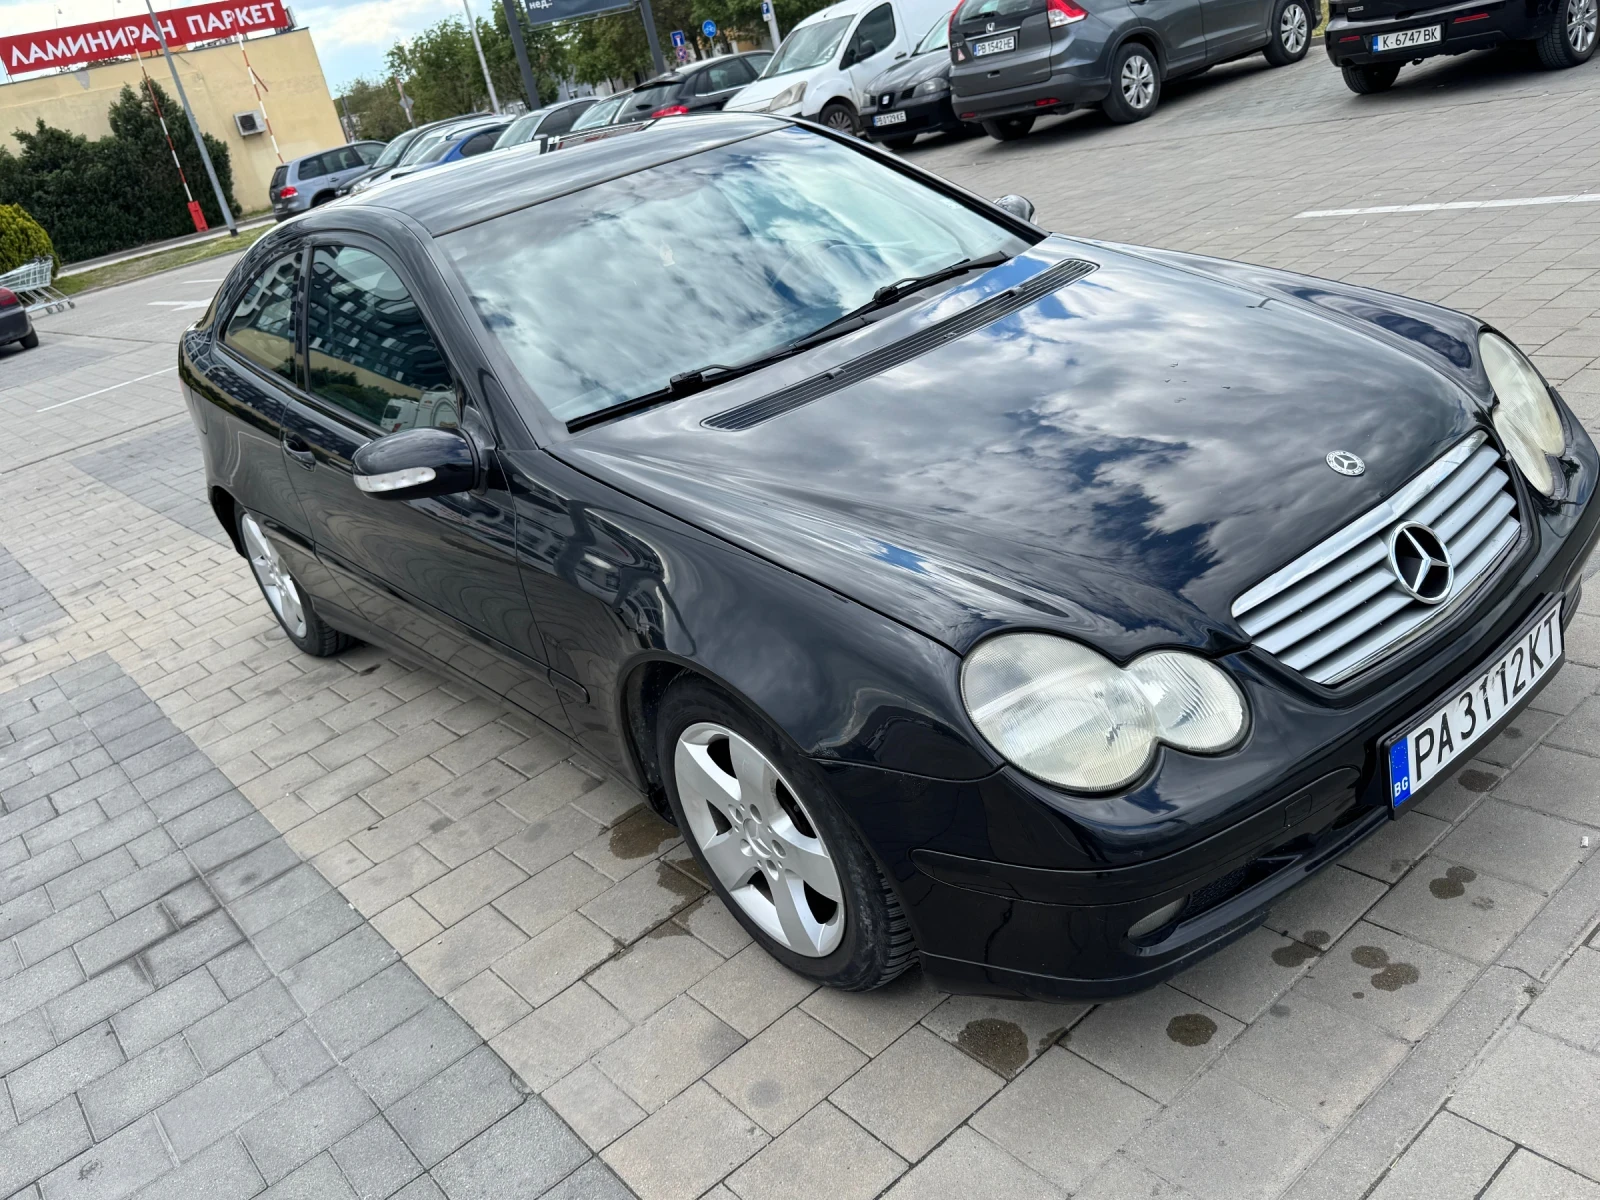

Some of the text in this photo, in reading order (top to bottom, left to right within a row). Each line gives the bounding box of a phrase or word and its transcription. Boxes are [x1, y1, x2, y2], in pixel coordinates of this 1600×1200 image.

[11, 2, 276, 67] ЛАМИНИРАН ПАРКЕТ
[1394, 776, 1409, 797] BG
